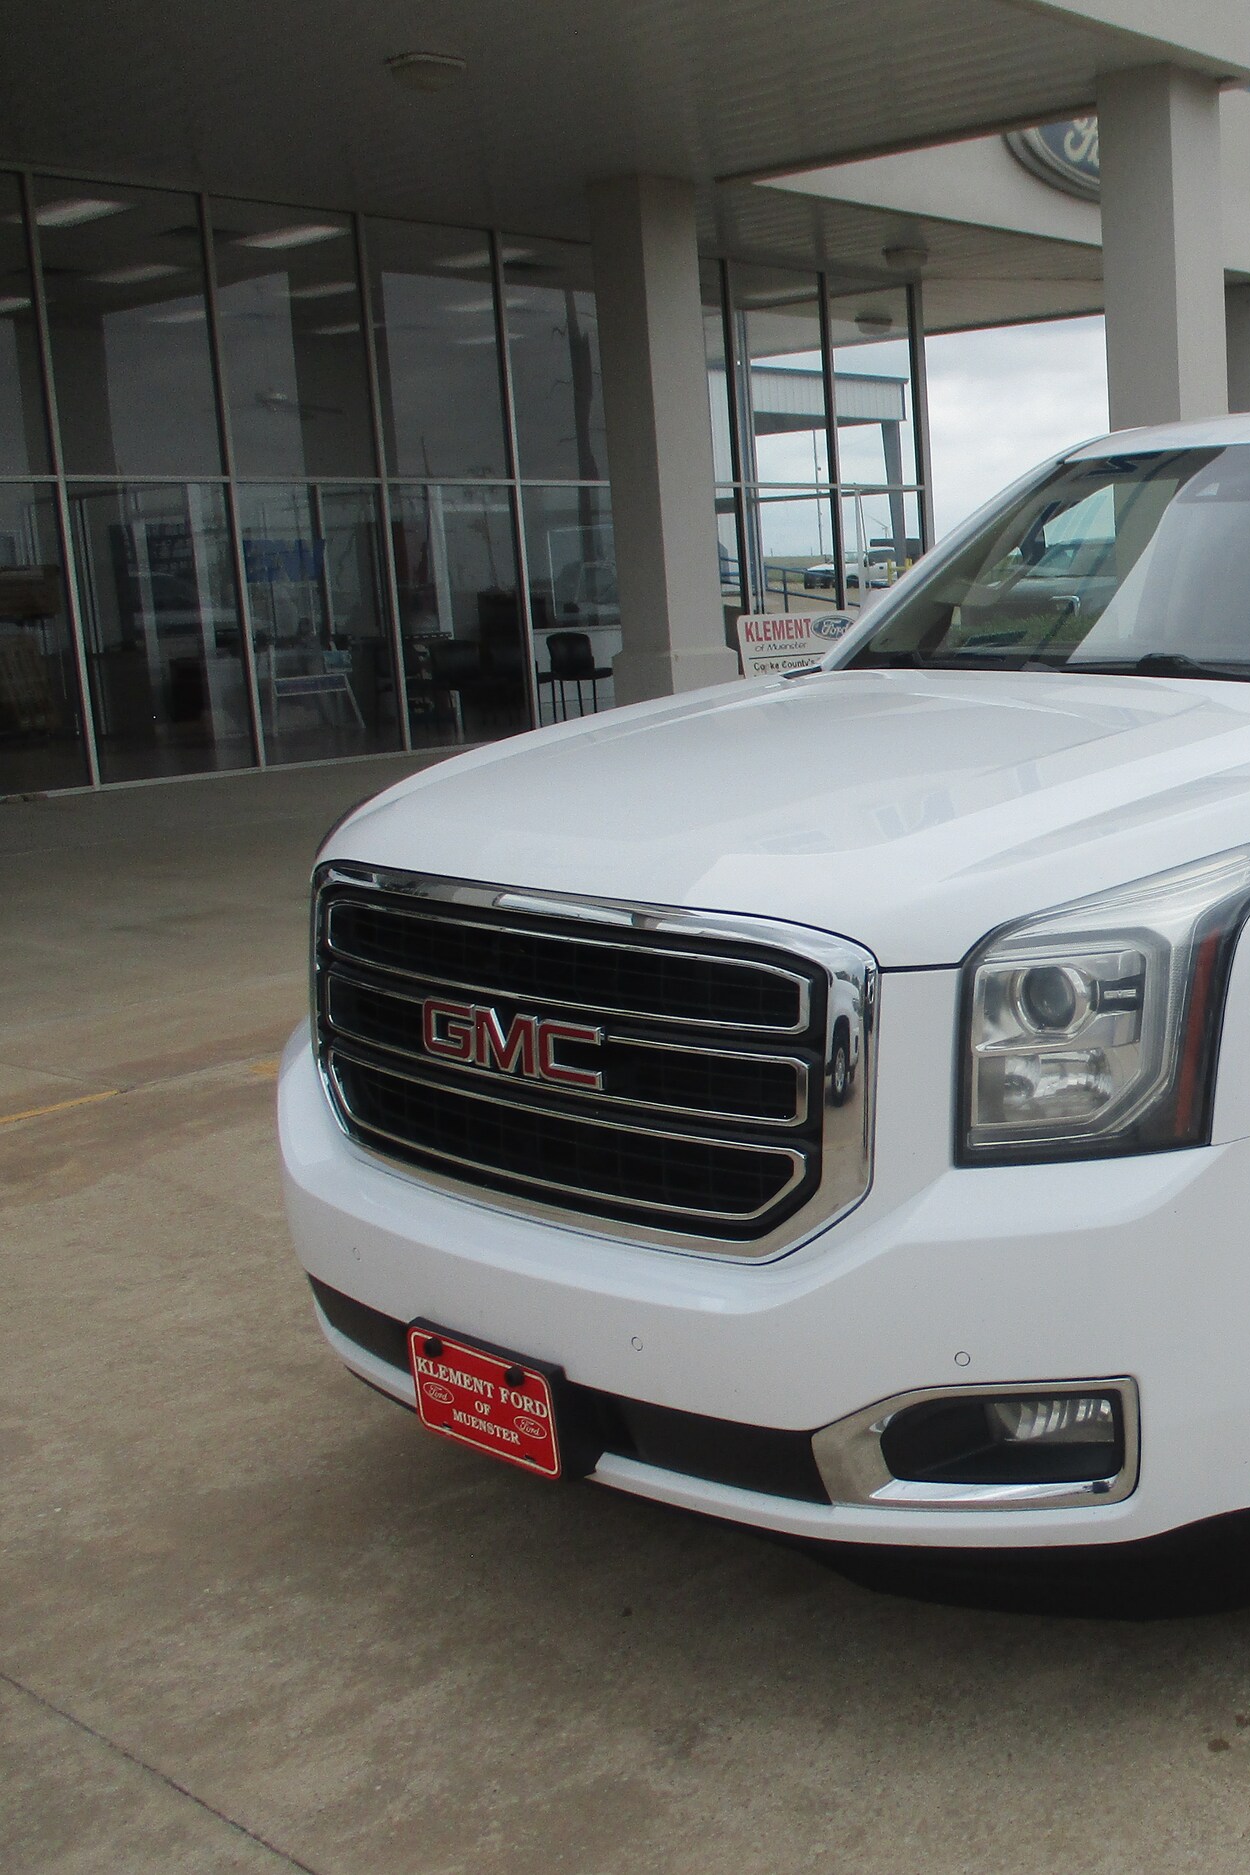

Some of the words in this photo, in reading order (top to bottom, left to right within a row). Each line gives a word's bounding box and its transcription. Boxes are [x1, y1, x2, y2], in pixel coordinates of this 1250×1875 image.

[745, 618, 812, 643] KLEMENT
[755, 643, 765, 653] of
[422, 998, 605, 1091] GMC
[416, 1355, 495, 1400] KLEMENT
[498, 1386, 548, 1419] FORD
[428, 1384, 449, 1402] Ford
[474, 1400, 491, 1416] OF
[452, 1408, 521, 1446] MUENSTER
[518, 1418, 541, 1436] Ford
